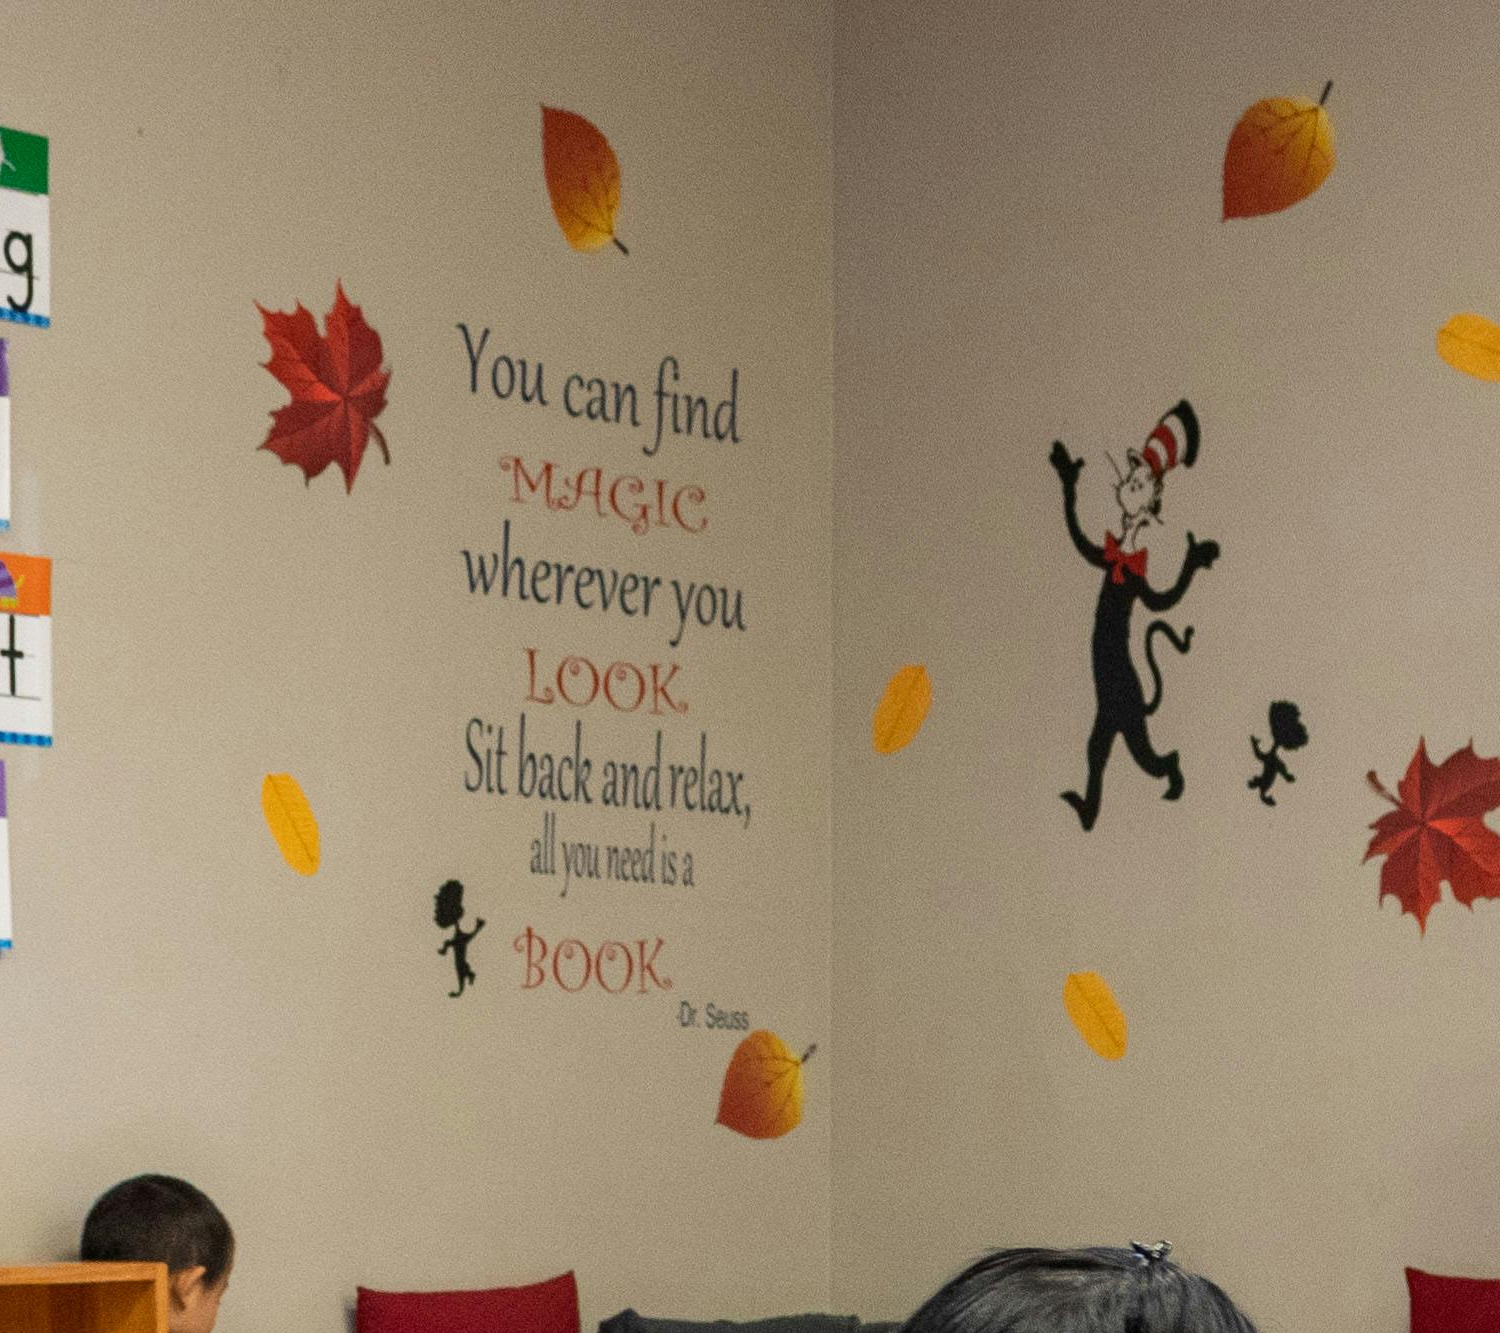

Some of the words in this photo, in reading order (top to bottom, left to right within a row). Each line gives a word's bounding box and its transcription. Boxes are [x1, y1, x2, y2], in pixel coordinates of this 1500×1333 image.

[456, 322, 548, 407] You
[562, 372, 642, 430] can
[642, 355, 742, 457] find
[500, 455, 710, 537] MAGIC
[460, 518, 662, 619] wherever
[670, 580, 748, 648] you
[519, 646, 689, 715] LOOK
[464, 717, 507, 796] Sit
[517, 712, 593, 804] back
[602, 729, 662, 812] and
[669, 731, 752, 830] relax,
[530, 810, 556, 876] all
[561, 840, 601, 898] you
[606, 820, 655, 884] need
[661, 834, 678, 887] is
[681, 851, 695, 887] a
[512, 926, 675, 995] BOOK
[705, 1001, 751, 1031] Seuss
